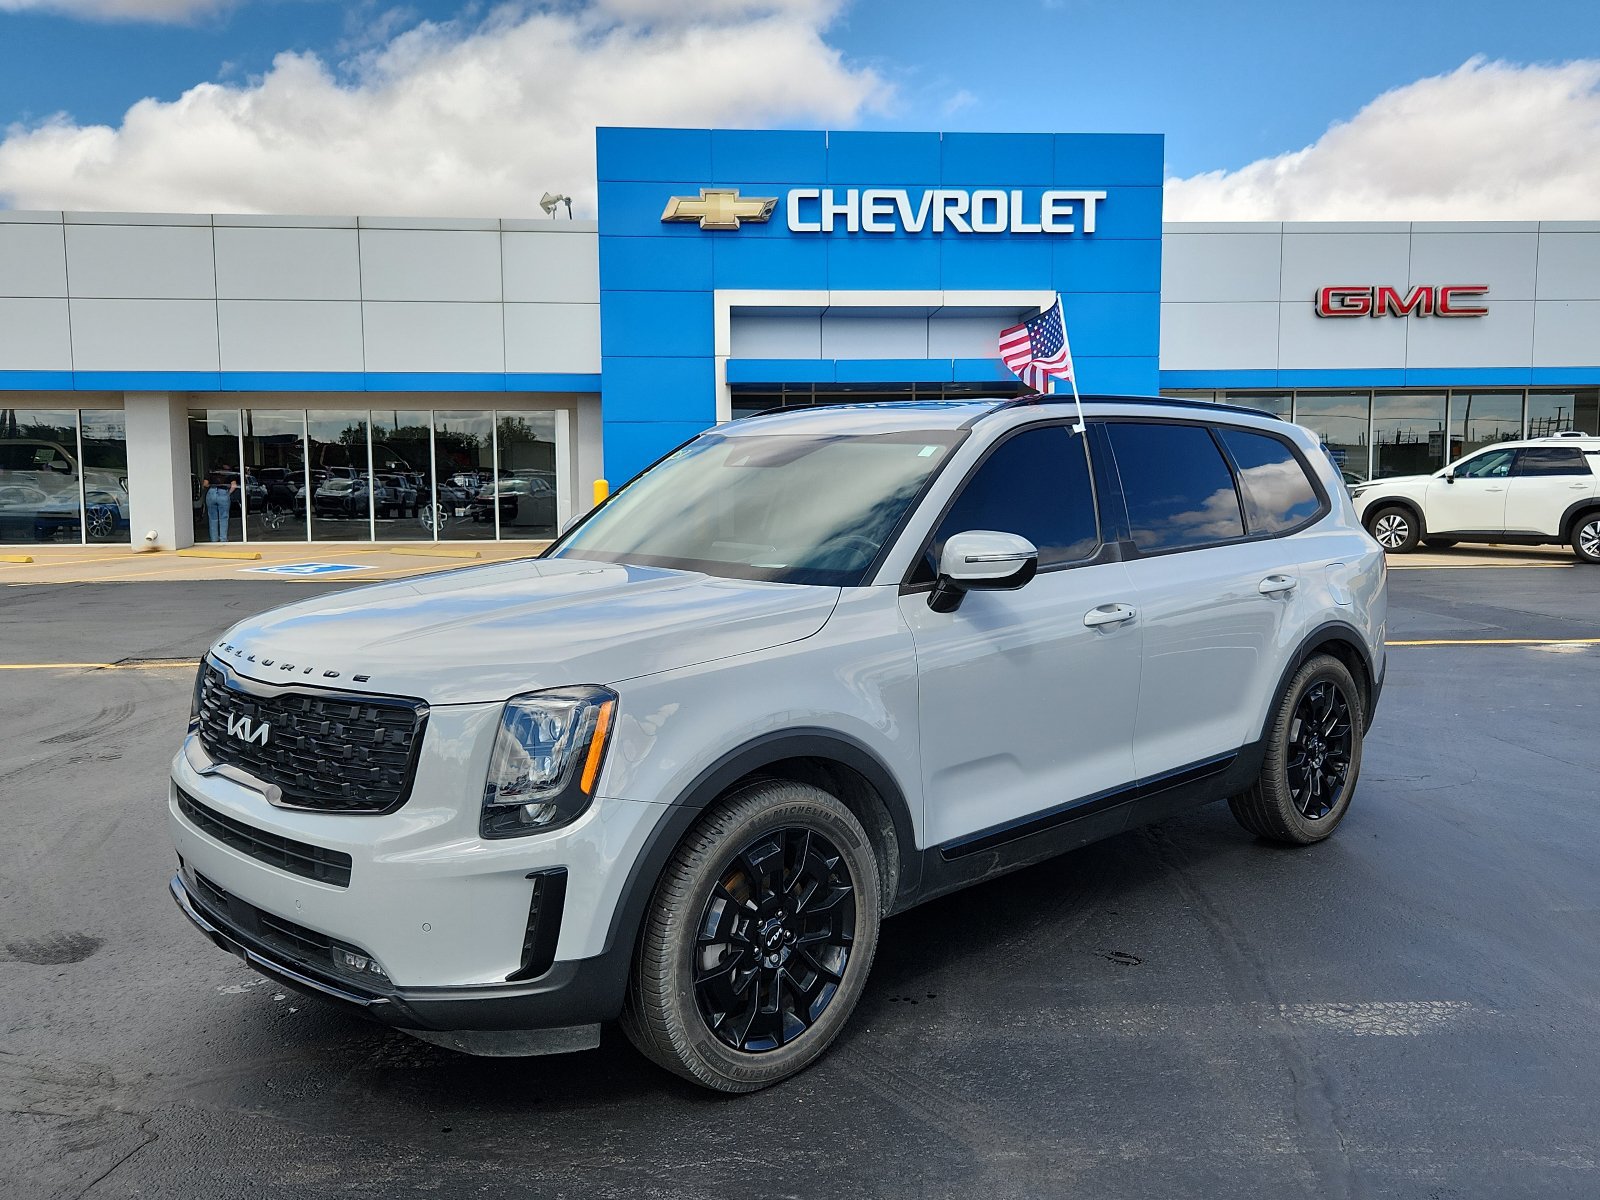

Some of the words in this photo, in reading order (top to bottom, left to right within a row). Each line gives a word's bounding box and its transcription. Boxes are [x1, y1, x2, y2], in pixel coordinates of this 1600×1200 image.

[787, 189, 1107, 233] CHEVROLET
[1316, 285, 1489, 318] GMC
[218, 642, 371, 683] TELLURIDE
[227, 712, 270, 746] KIA
[772, 806, 832, 821] MICHELIN
